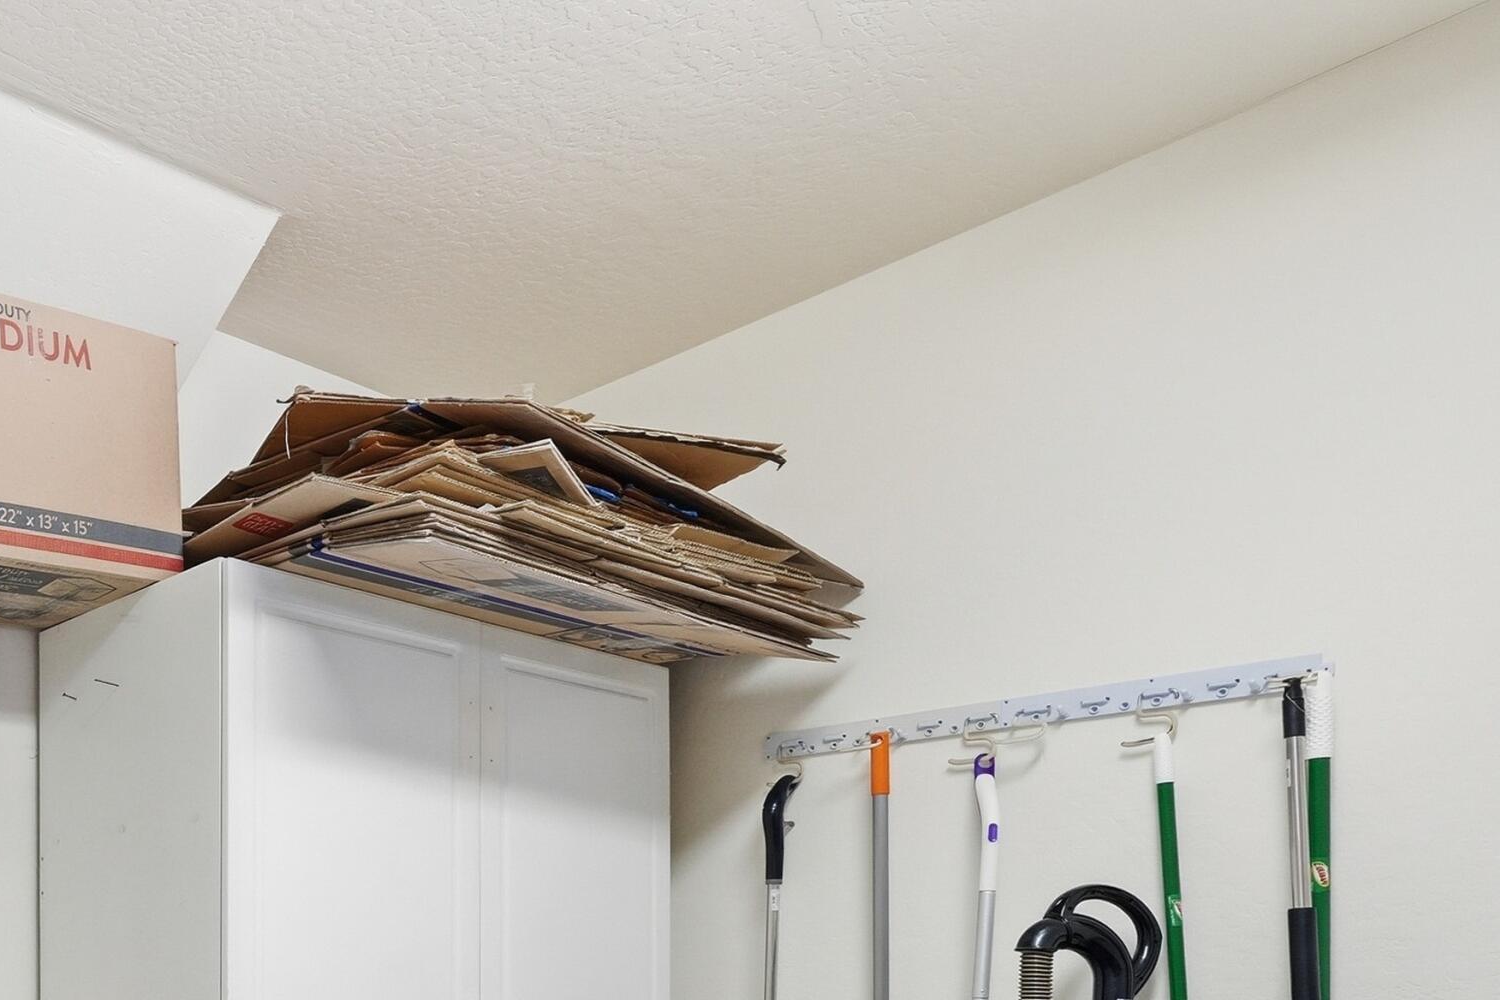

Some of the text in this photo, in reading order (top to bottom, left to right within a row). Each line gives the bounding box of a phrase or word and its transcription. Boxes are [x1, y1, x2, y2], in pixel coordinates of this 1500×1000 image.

[26, 515, 35, 527] x
[38, 513, 58, 530] 13"
[61, 521, 70, 533] x
[73, 519, 93, 536] 15"
